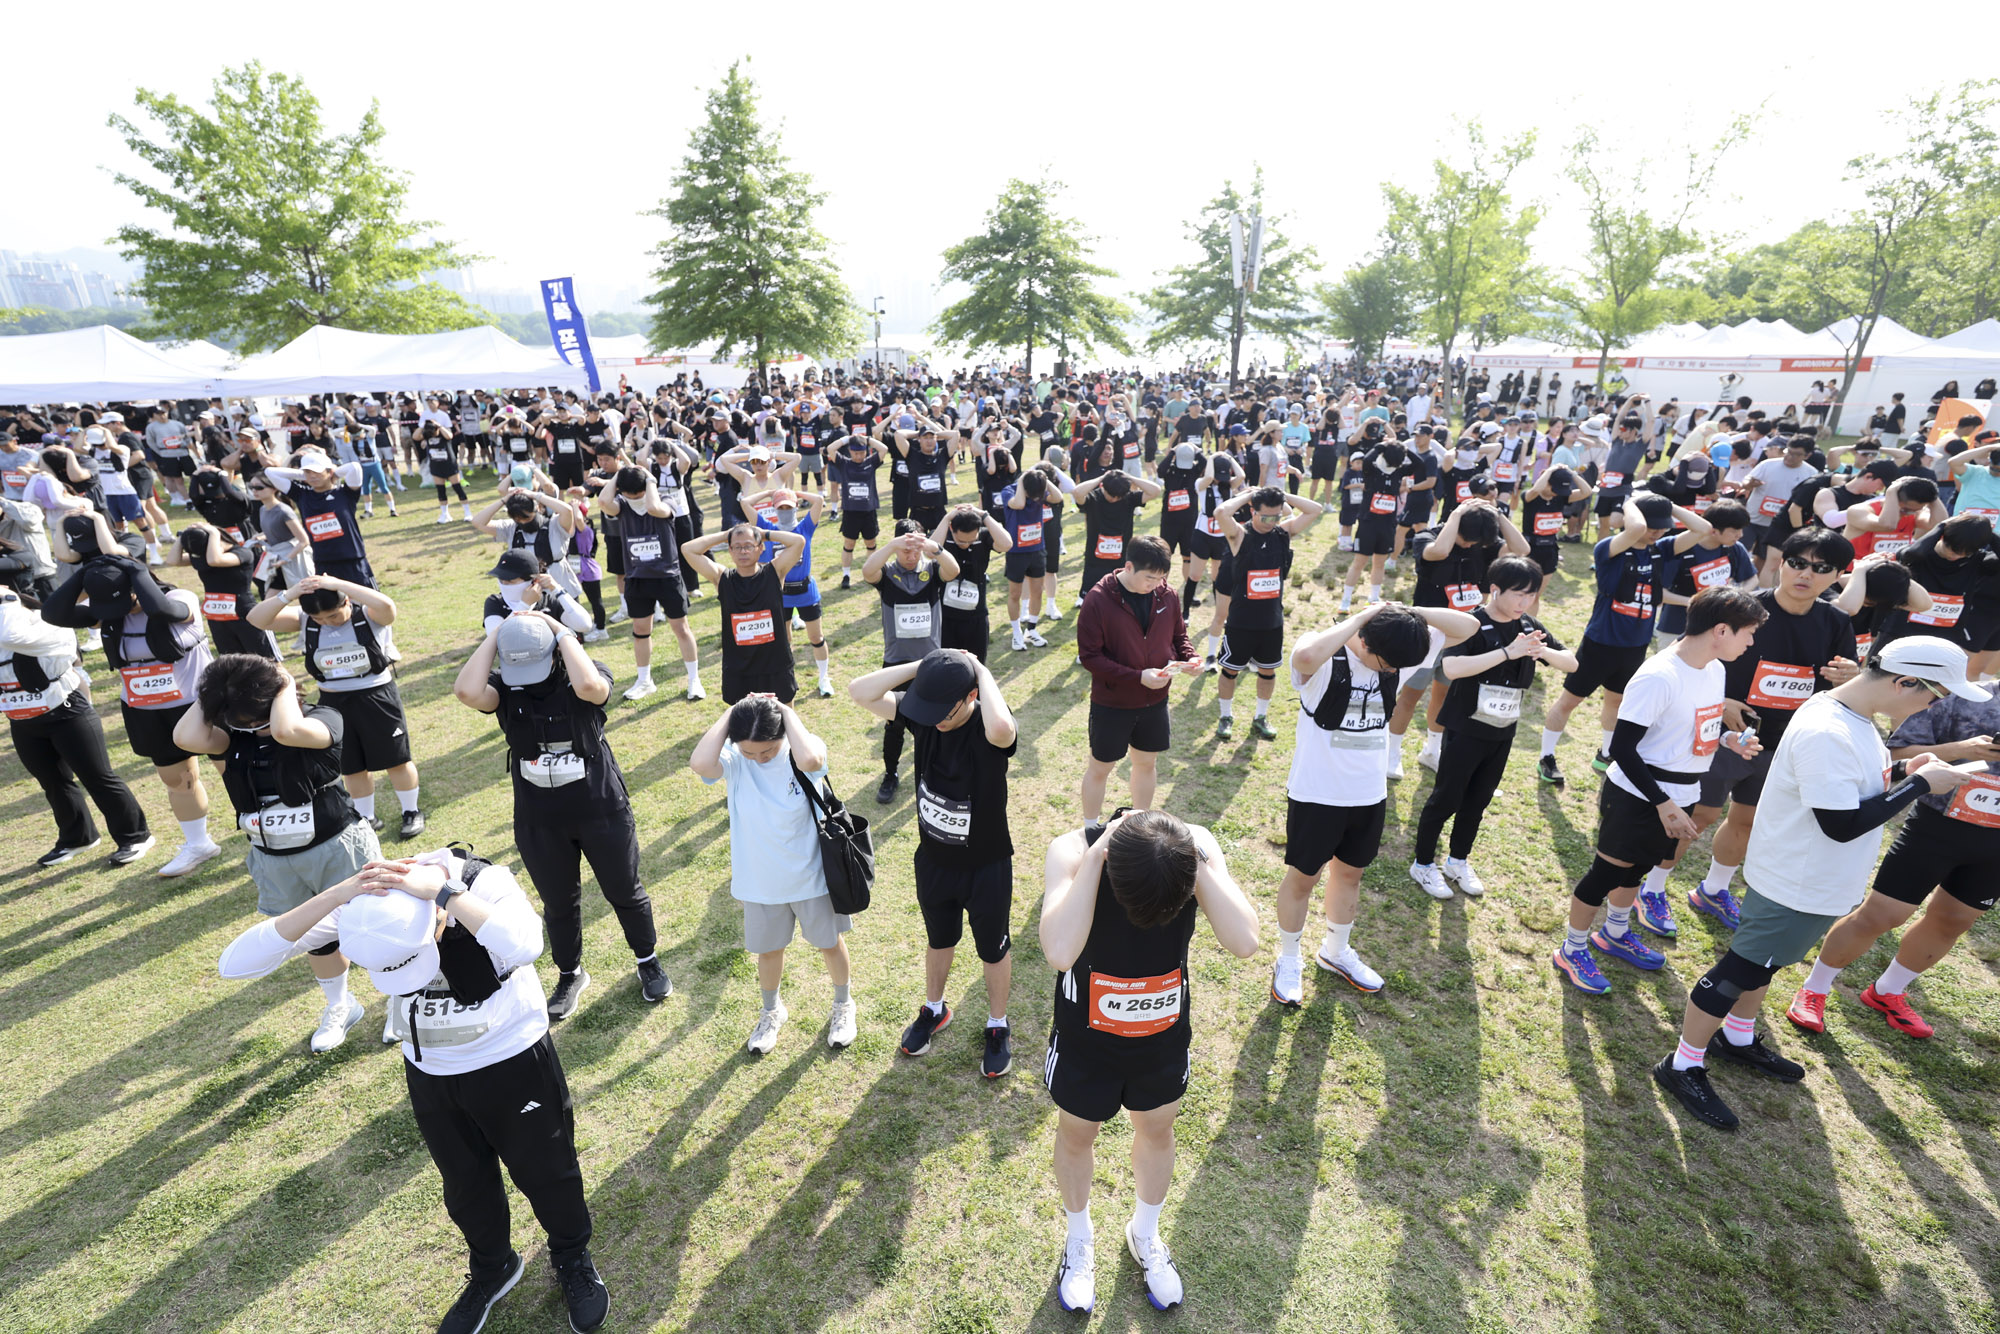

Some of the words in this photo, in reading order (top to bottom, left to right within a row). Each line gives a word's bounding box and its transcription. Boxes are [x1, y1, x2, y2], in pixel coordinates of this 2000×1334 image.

[909, 615, 930, 624] 5238
[748, 621, 770, 631] 2301
[336, 653, 366, 665] 5899
[143, 677, 173, 688] 4295
[1781, 680, 1813, 691] 1806
[10, 692, 43, 703] 4139
[1974, 794, 1989, 803] M
[265, 812, 311, 827] 5713
[922, 804, 929, 813] M
[932, 809, 968, 827] 7253
[1095, 979, 1129, 989] BURNING
[1107, 1000, 1121, 1010] M
[1125, 993, 1177, 1011] 2655
